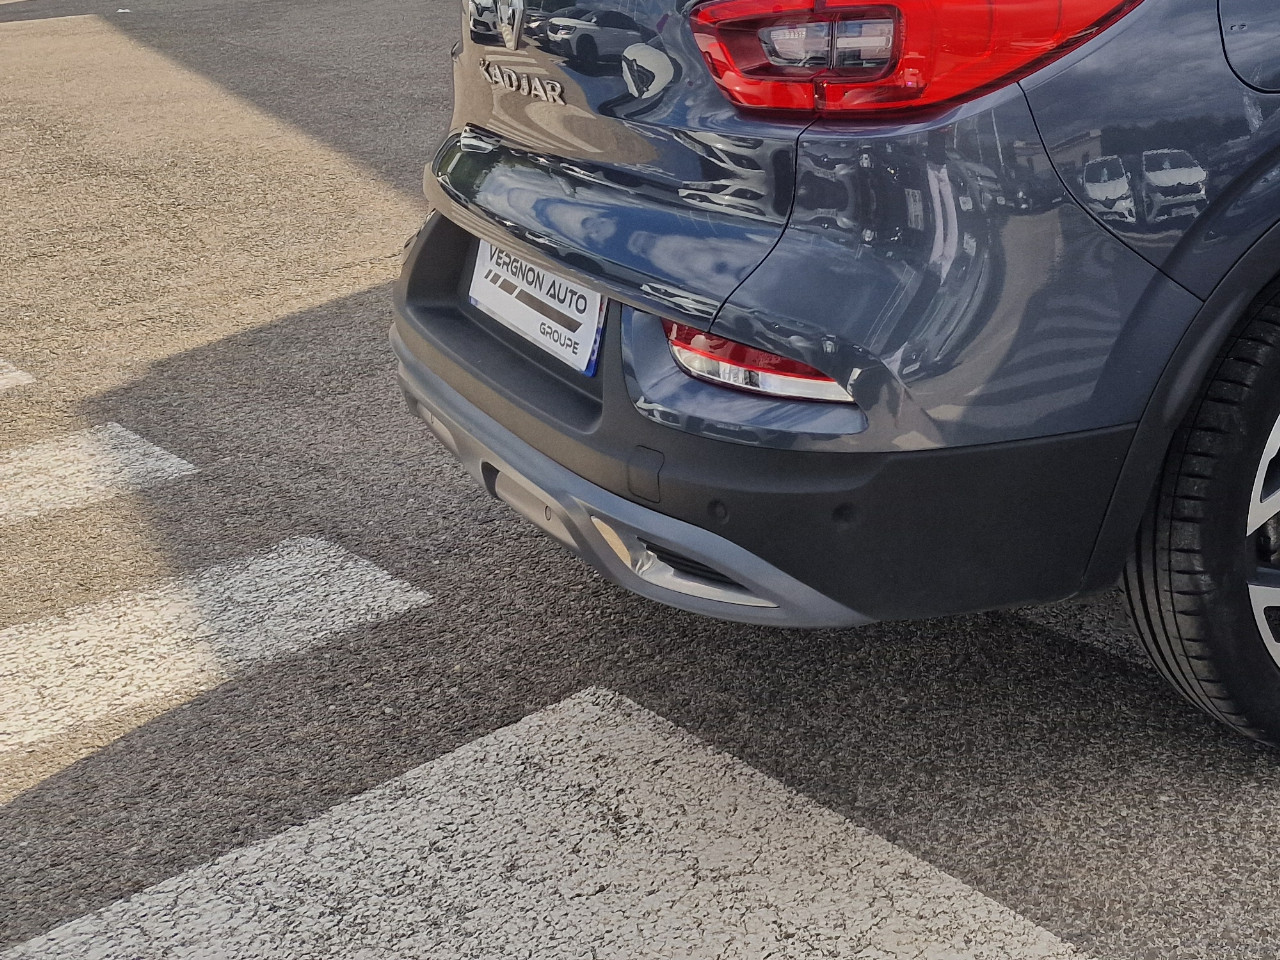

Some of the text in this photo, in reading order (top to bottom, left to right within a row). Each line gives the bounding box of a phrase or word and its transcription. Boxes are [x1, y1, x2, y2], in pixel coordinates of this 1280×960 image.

[479, 58, 568, 106] KADJAR
[489, 243, 588, 315] VERGNON AUTO
[539, 321, 580, 356] GROUPE
